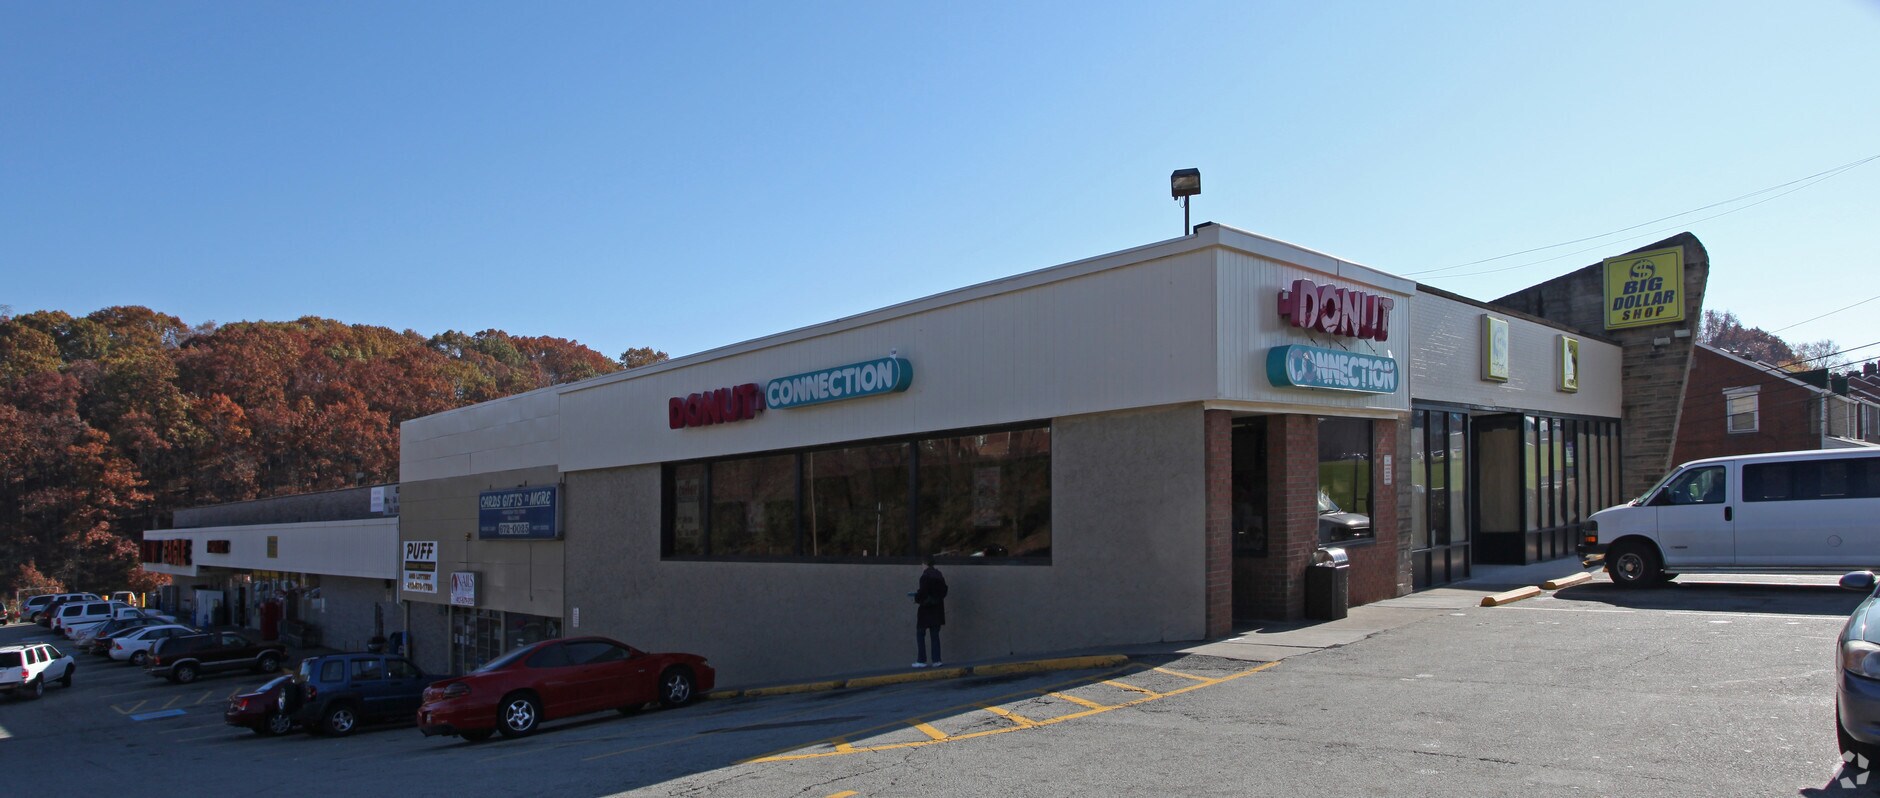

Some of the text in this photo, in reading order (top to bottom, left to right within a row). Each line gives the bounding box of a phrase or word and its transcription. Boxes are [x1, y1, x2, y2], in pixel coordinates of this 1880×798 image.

[1623, 277, 1663, 295] BIG
[1612, 290, 1675, 311] DOLLAR
[1293, 279, 1395, 341] DONUT
[1622, 306, 1665, 321] SHOP
[1291, 351, 1394, 389] CONNECTION
[669, 360, 893, 429] DONUT CONNECTION
[480, 494, 502, 508] CARDS
[502, 493, 523, 507] GIFTS
[529, 490, 551, 505] MORE
[406, 542, 434, 560] PUFF
[454, 573, 474, 588] NAILS
